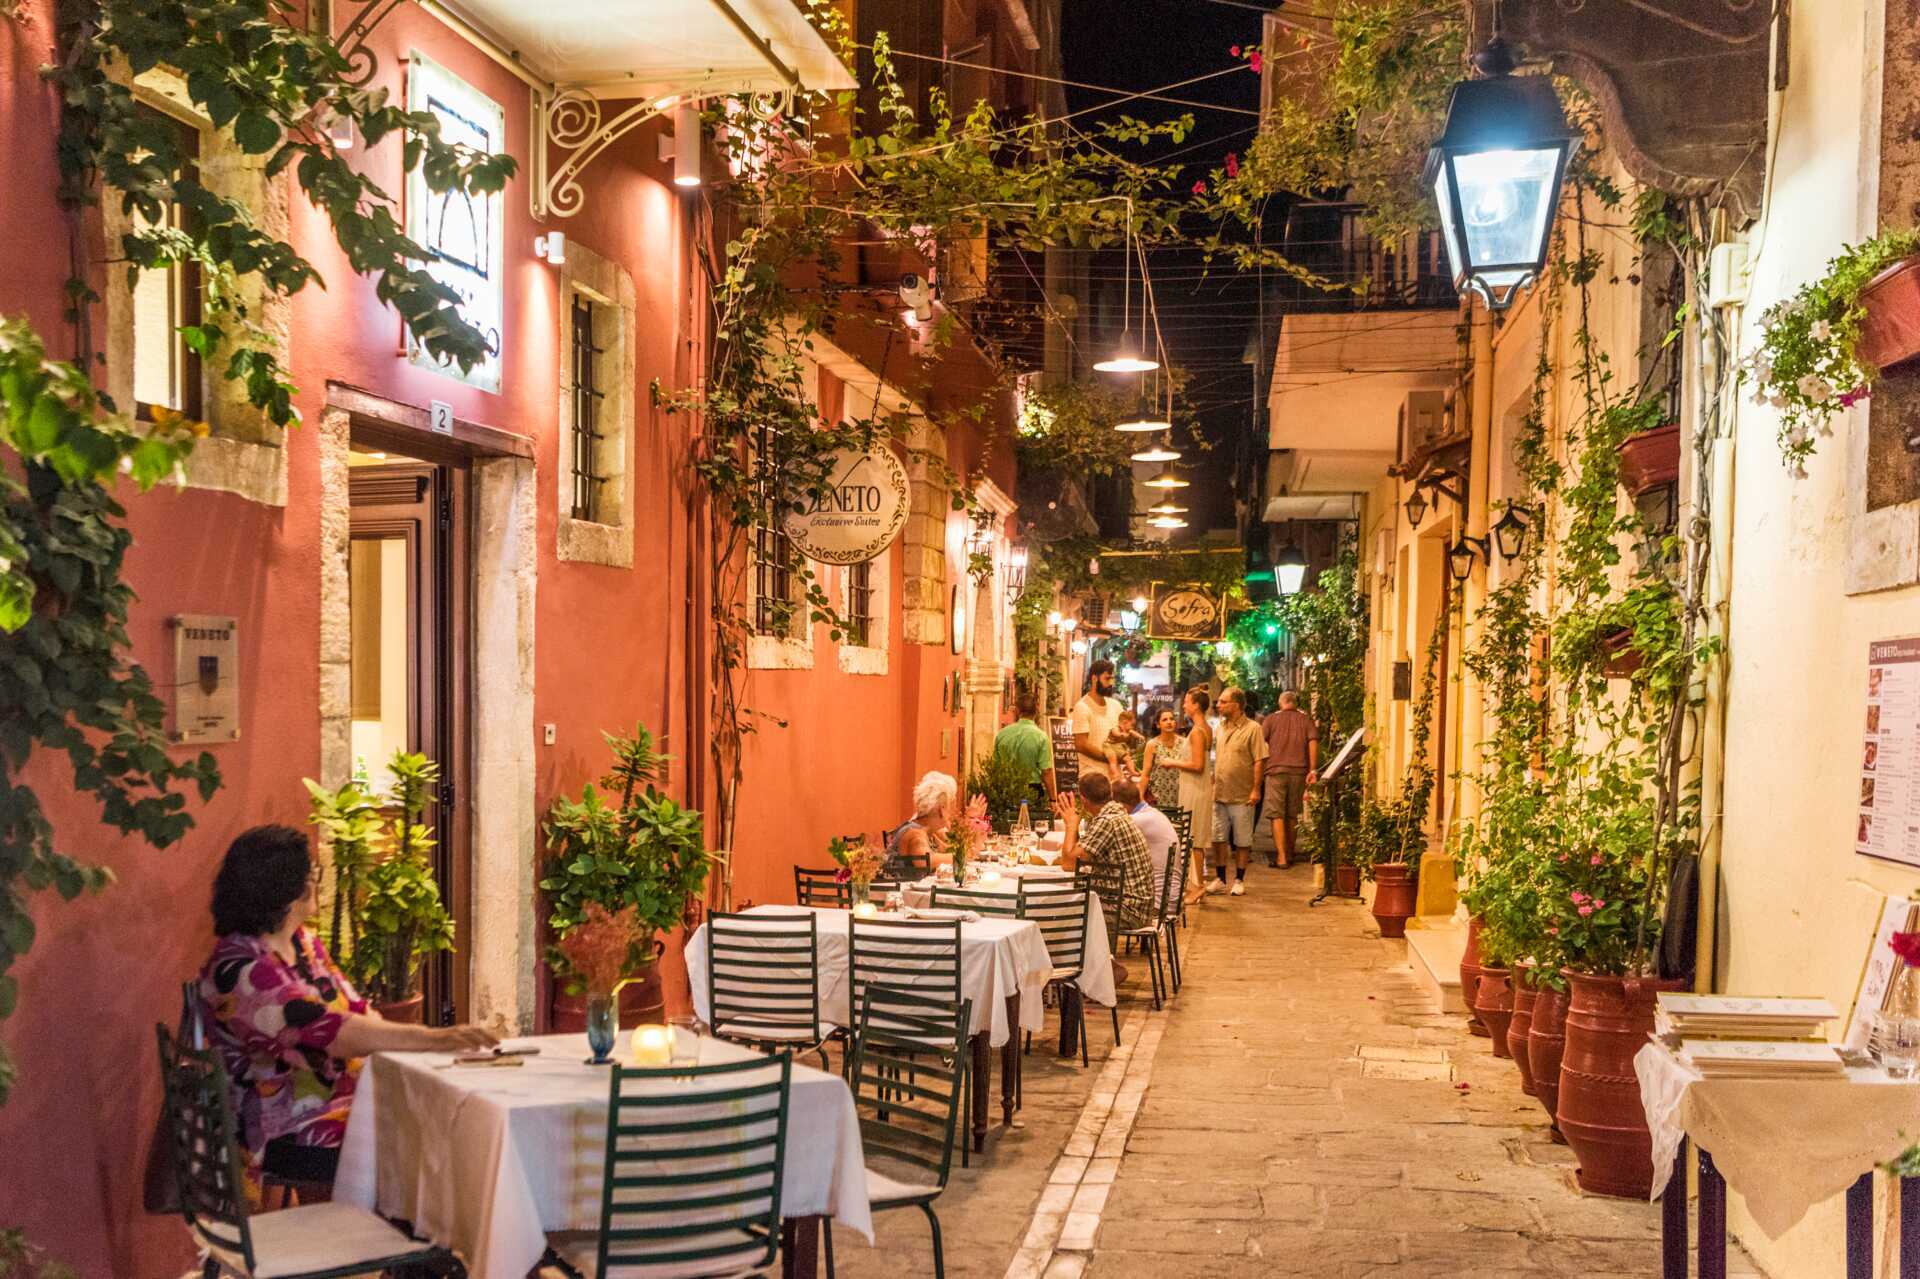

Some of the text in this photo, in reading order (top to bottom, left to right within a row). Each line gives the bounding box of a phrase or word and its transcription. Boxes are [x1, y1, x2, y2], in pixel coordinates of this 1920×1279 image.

[438, 408, 447, 429] 2
[854, 515, 880, 527] Suites
[1163, 597, 1211, 619] Sofra
